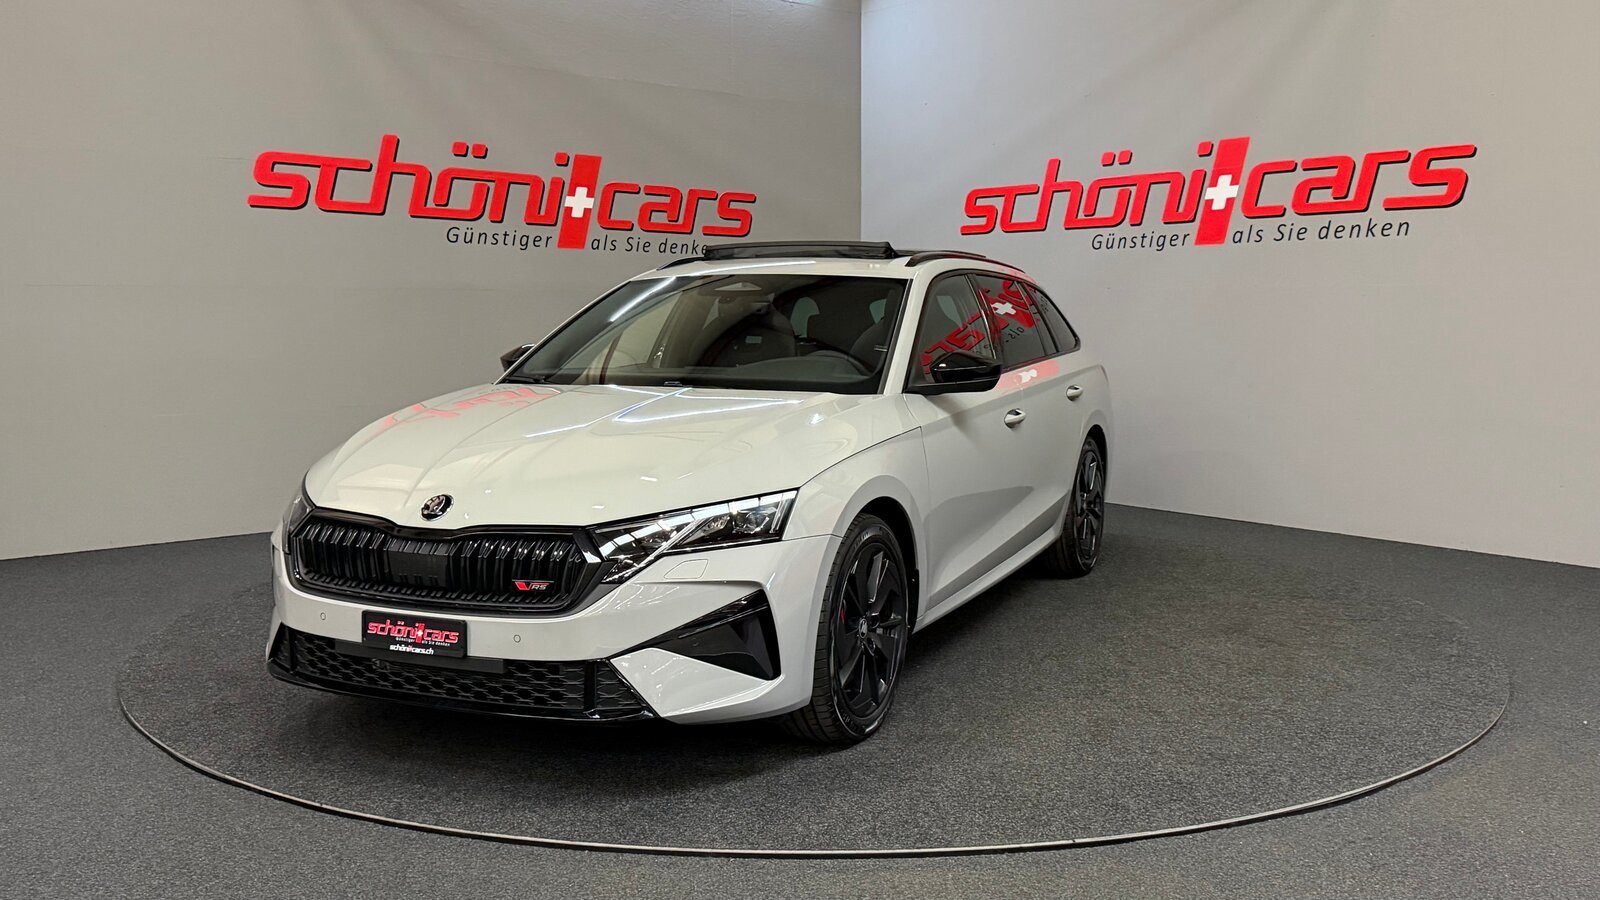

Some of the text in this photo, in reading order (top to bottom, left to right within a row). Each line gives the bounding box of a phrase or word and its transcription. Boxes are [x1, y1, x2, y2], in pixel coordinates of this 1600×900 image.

[446, 227, 707, 255] Günstiger als Sie denke
[1091, 218, 1410, 252] Günstiger als Sie denken
